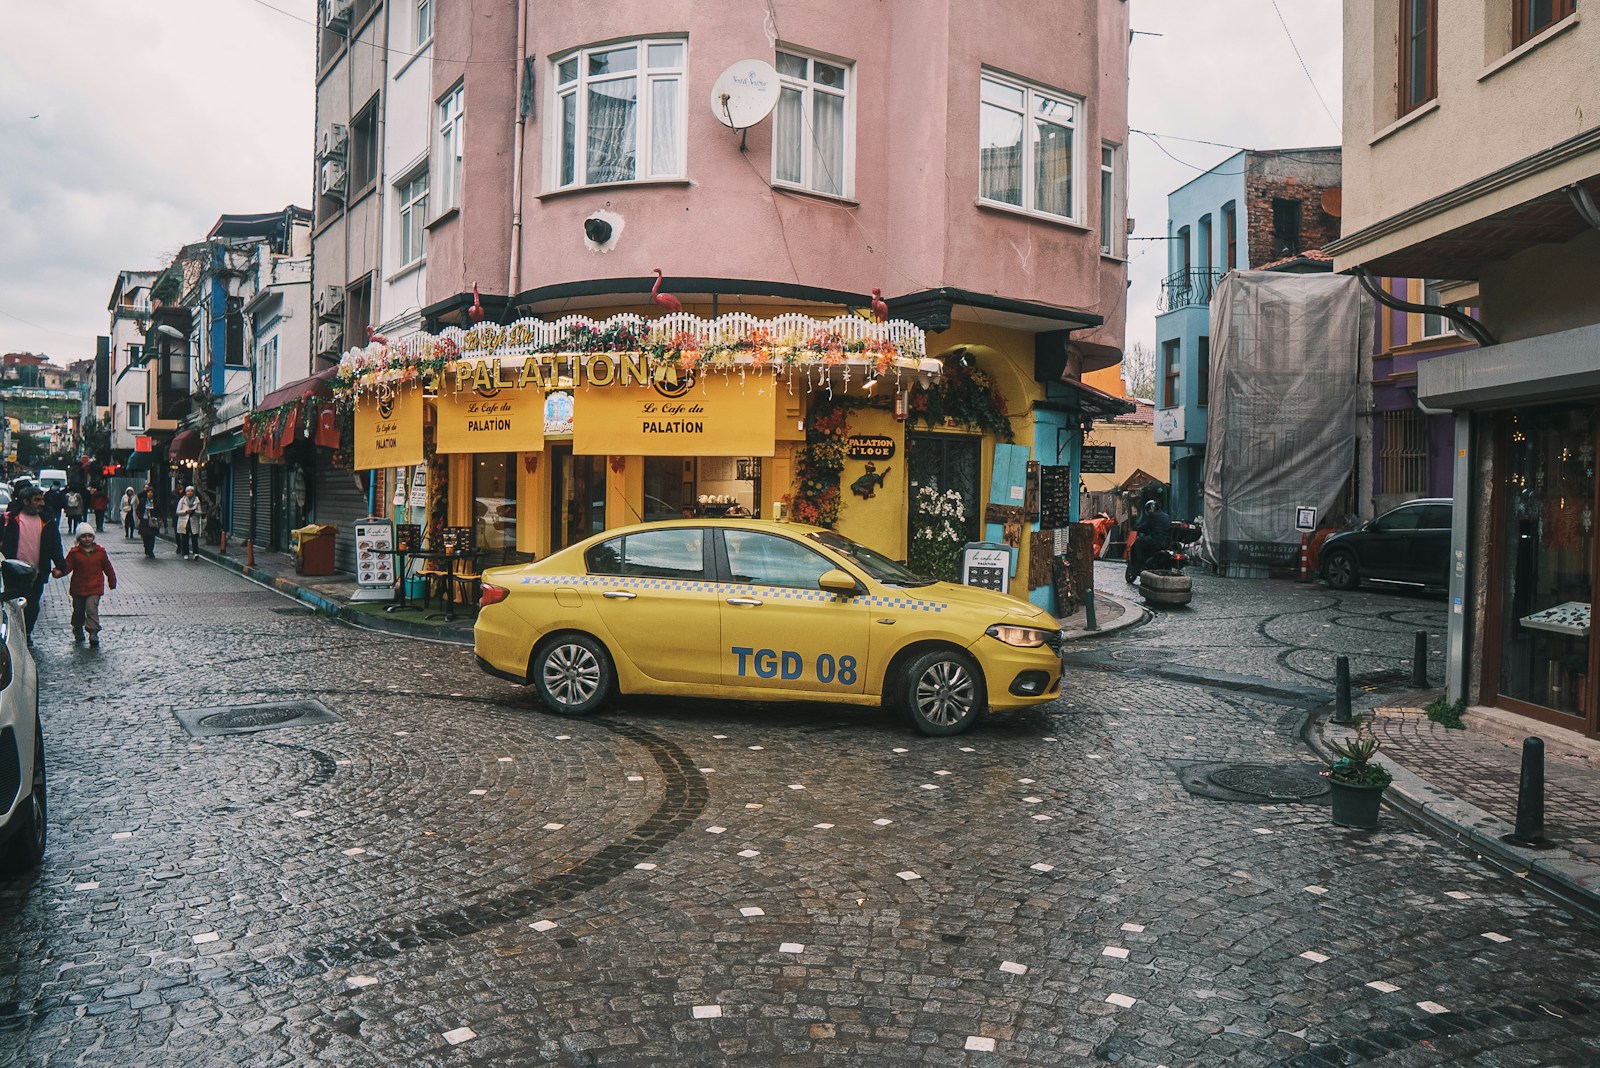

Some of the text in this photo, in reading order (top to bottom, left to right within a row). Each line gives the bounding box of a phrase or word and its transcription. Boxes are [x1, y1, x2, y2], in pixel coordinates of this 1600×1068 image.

[456, 353, 651, 392] PALATION
[468, 402, 511, 415] Le Cafe du
[641, 402, 704, 416] Le Cafe du
[849, 439, 893, 447] PALATION
[732, 647, 857, 684] TGD 08
